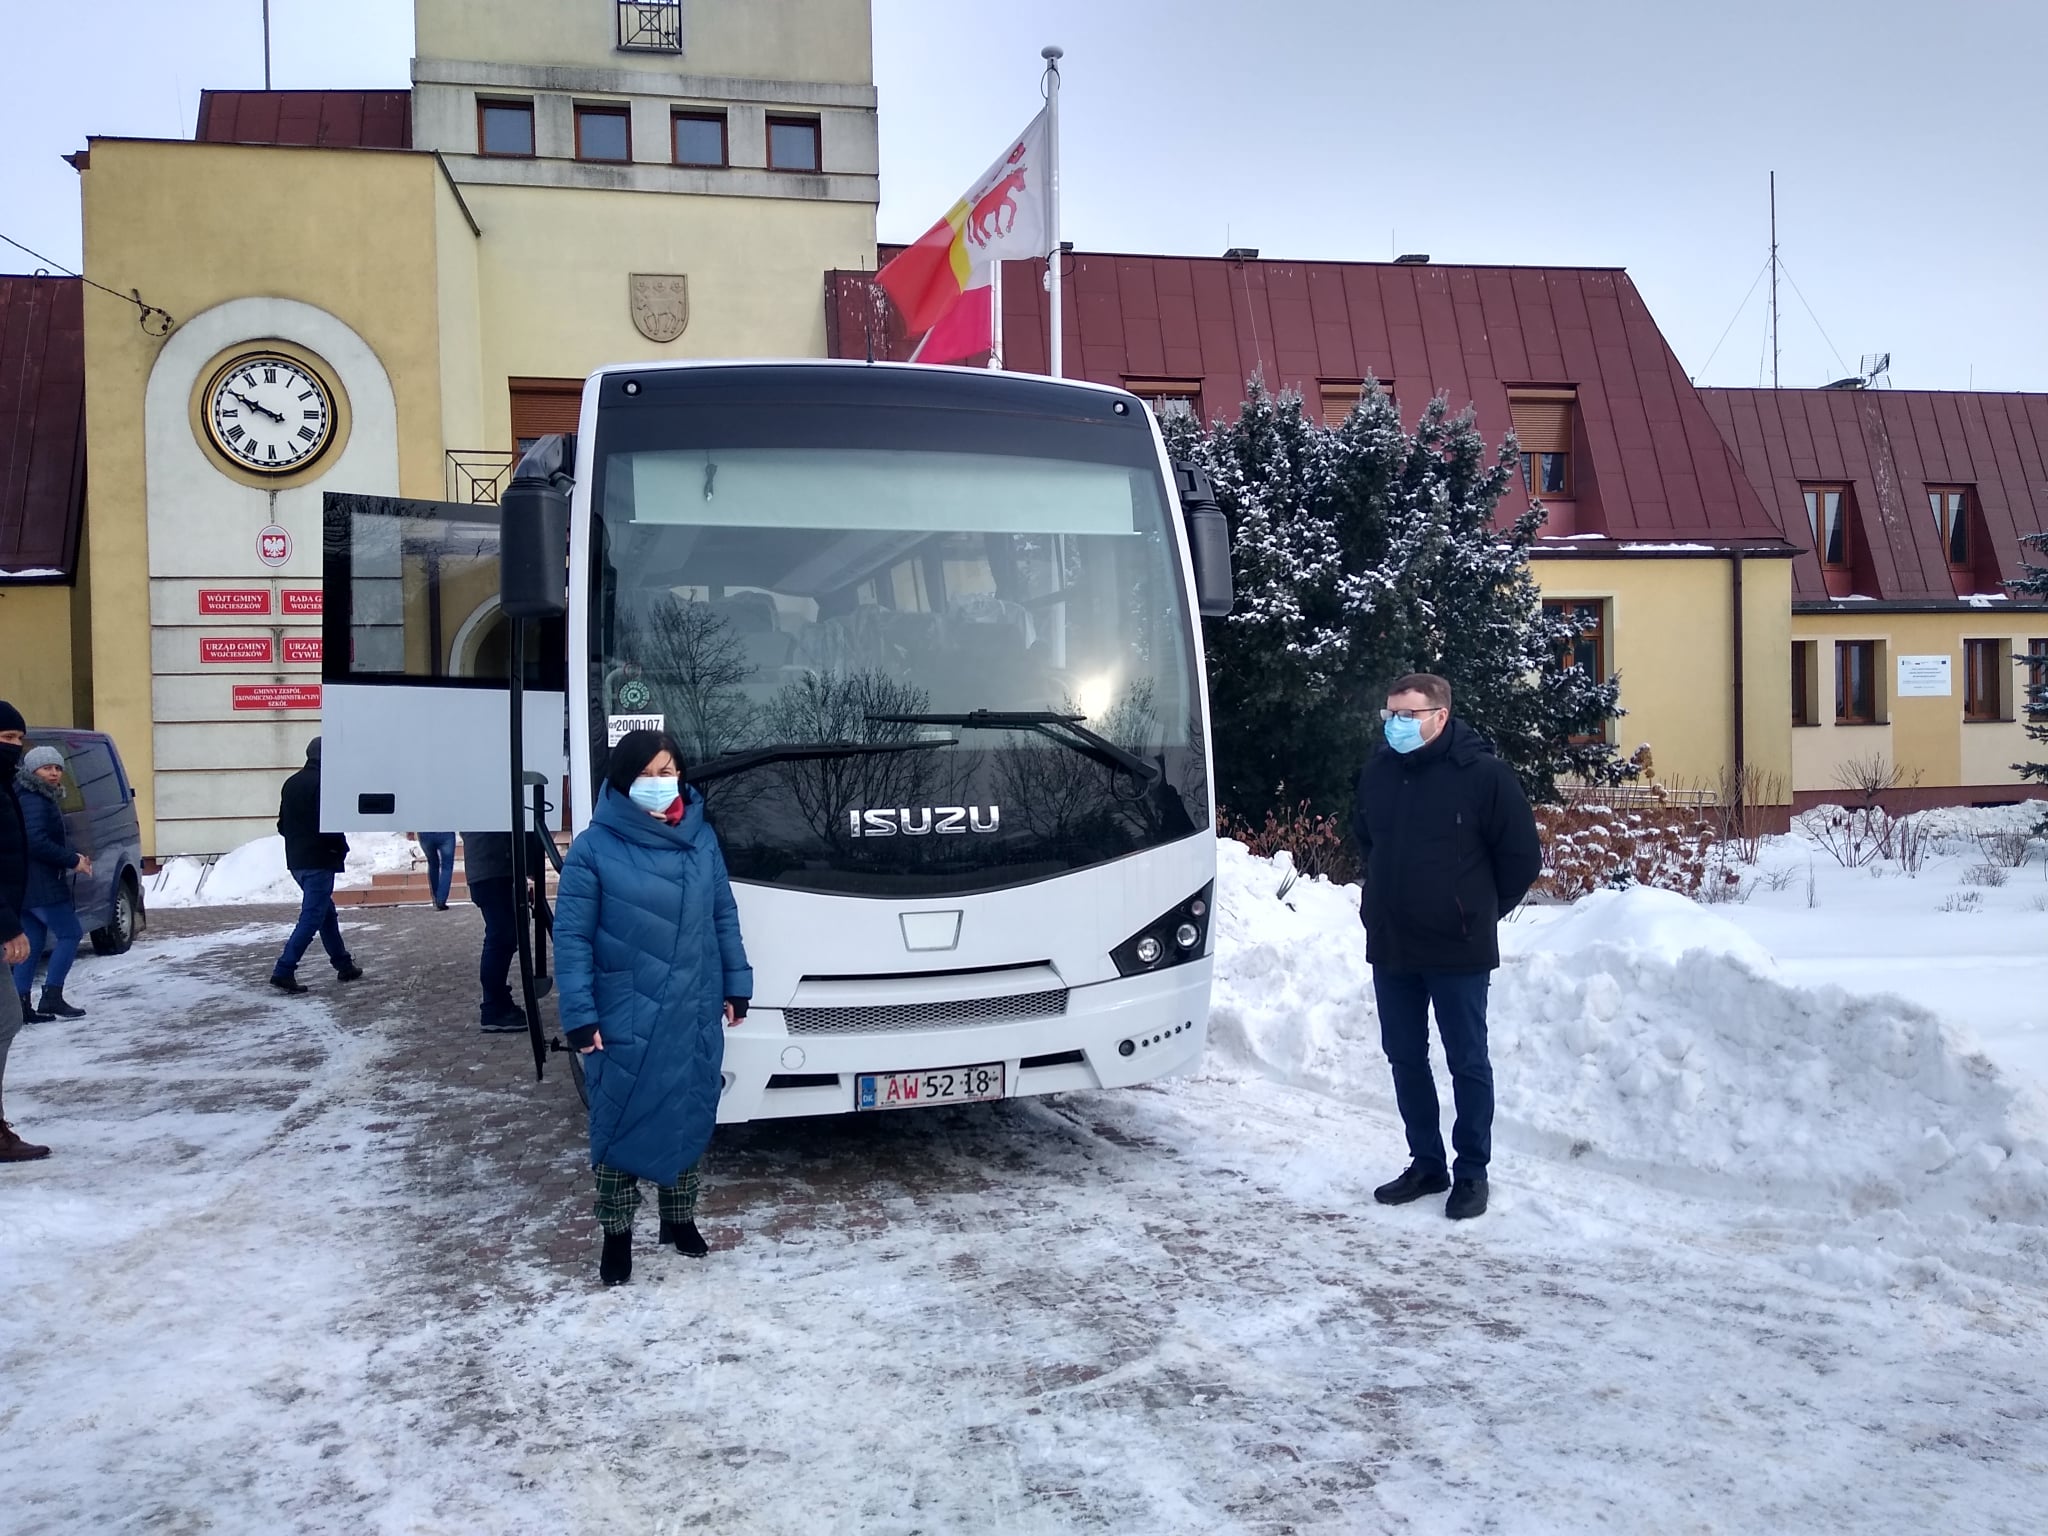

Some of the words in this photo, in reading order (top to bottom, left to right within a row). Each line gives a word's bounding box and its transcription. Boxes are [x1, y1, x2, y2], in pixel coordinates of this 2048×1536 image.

[264, 369, 277, 383] XII
[206, 594, 232, 602] WÓJT
[233, 594, 263, 602] GMINY
[205, 643, 235, 652] URZĄD
[289, 643, 318, 652] URZĄD
[616, 719, 660, 732] 2000107
[850, 805, 999, 838] ISUZU
[887, 1077, 919, 1100] AW
[926, 1075, 954, 1098] 52
[964, 1070, 989, 1095] 18
